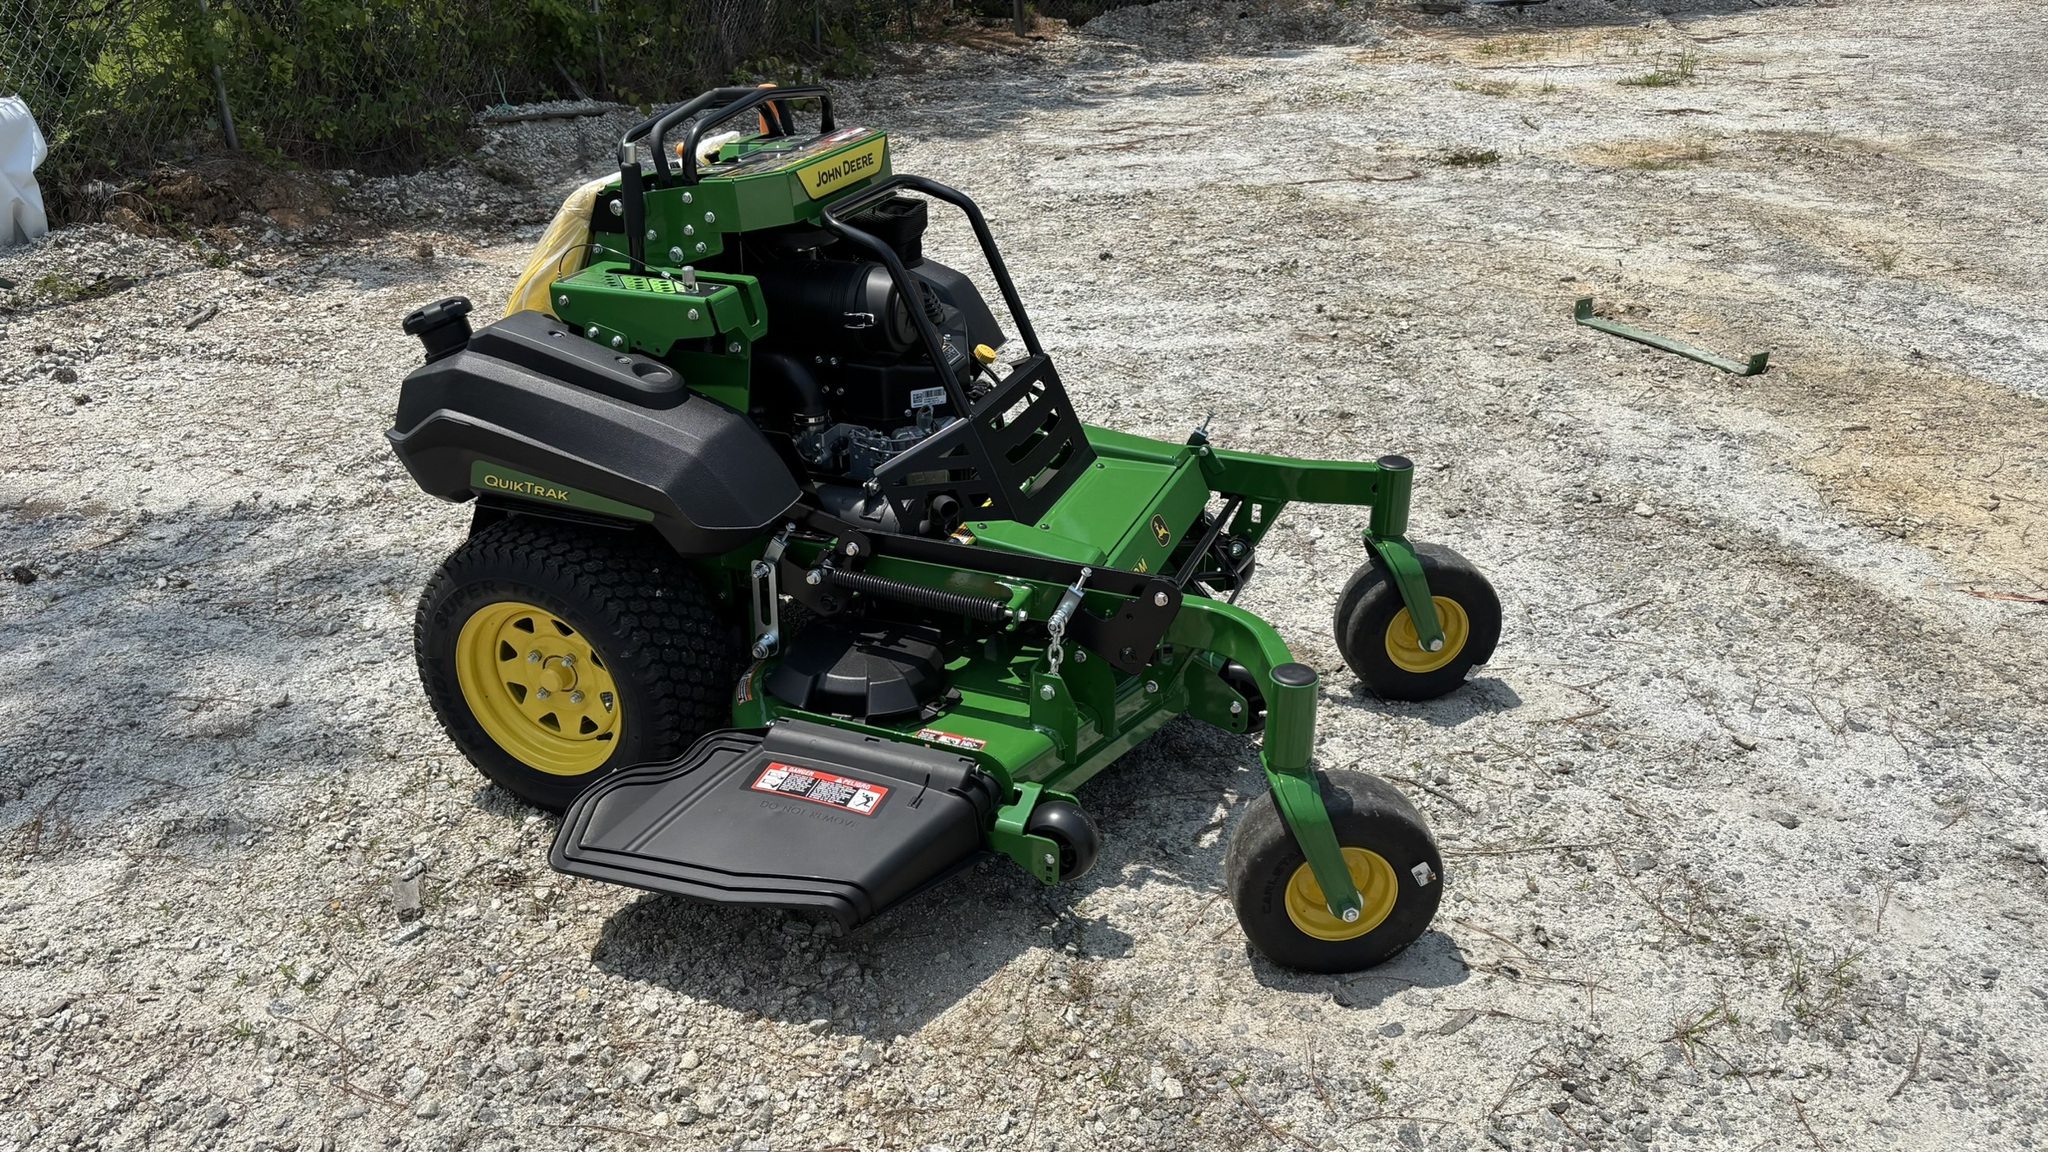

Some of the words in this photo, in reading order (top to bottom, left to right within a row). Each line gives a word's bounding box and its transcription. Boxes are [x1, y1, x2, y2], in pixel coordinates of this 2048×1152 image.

[816, 165, 842, 188] JOHN
[843, 152, 874, 176] DEERE
[434, 578, 499, 630] SUPER
[788, 766, 815, 777] DANGER
[842, 778, 872, 789] PELIGRO
[760, 800, 779, 810] DO
[782, 805, 807, 816] NOT
[809, 811, 859, 828] REMOVE
